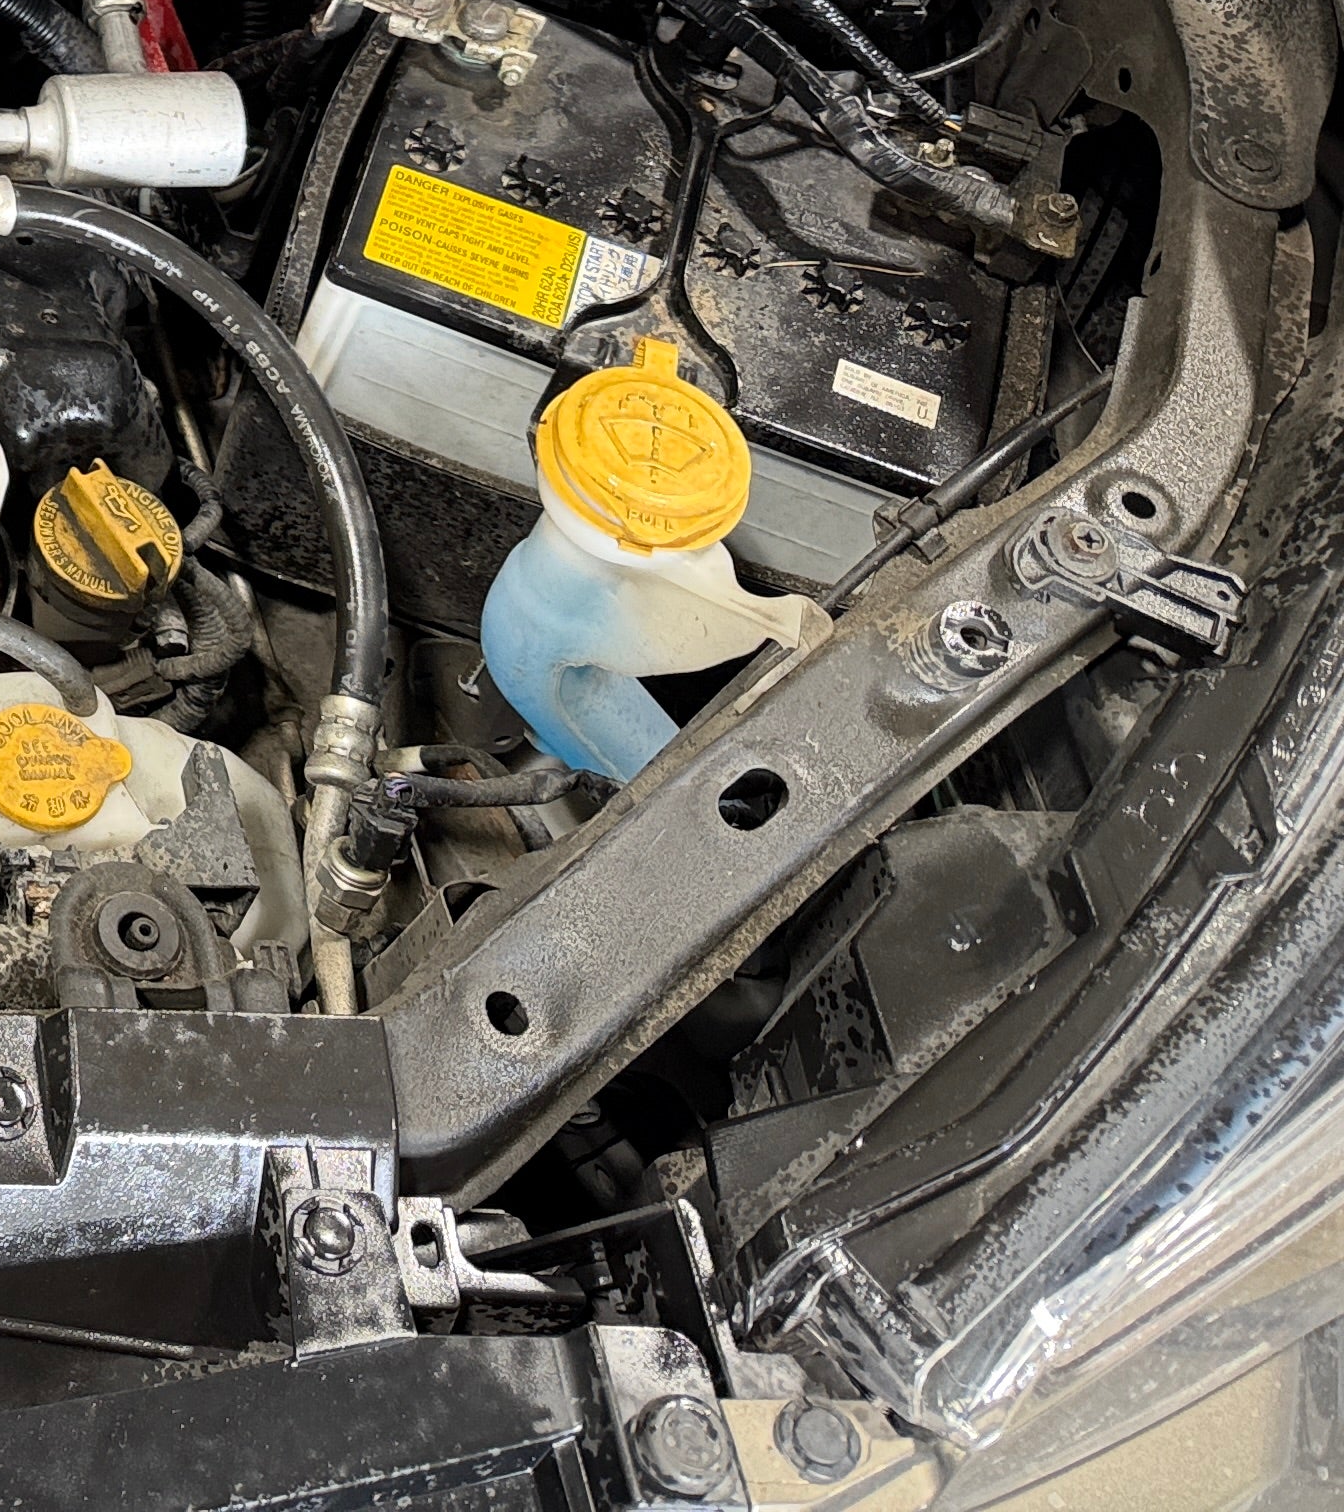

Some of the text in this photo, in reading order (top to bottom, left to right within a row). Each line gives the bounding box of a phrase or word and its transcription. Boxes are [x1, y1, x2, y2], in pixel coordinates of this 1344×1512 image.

[395, 170, 450, 197] DANGER
[393, 209, 531, 265] KEEP VENT CAPS TIGHT AND LEVEL
[469, 252, 500, 269] SEVERE
[502, 263, 530, 280] BURNS
[582, 240, 609, 275] START
[379, 252, 401, 265] KEEP
[402, 260, 419, 272] OUT
[421, 267, 432, 276] OF
[433, 271, 461, 288] REACH
[462, 282, 474, 292] OF
[474, 287, 517, 308] CHILDREN
[530, 265, 557, 319] 20HR 62Ah
[192, 288, 220, 313] HP
[627, 509, 677, 533] PULL
[40, 495, 59, 519] SEE
[64, 561, 115, 594] MANUAL
[21, 738, 53, 755] SEE
